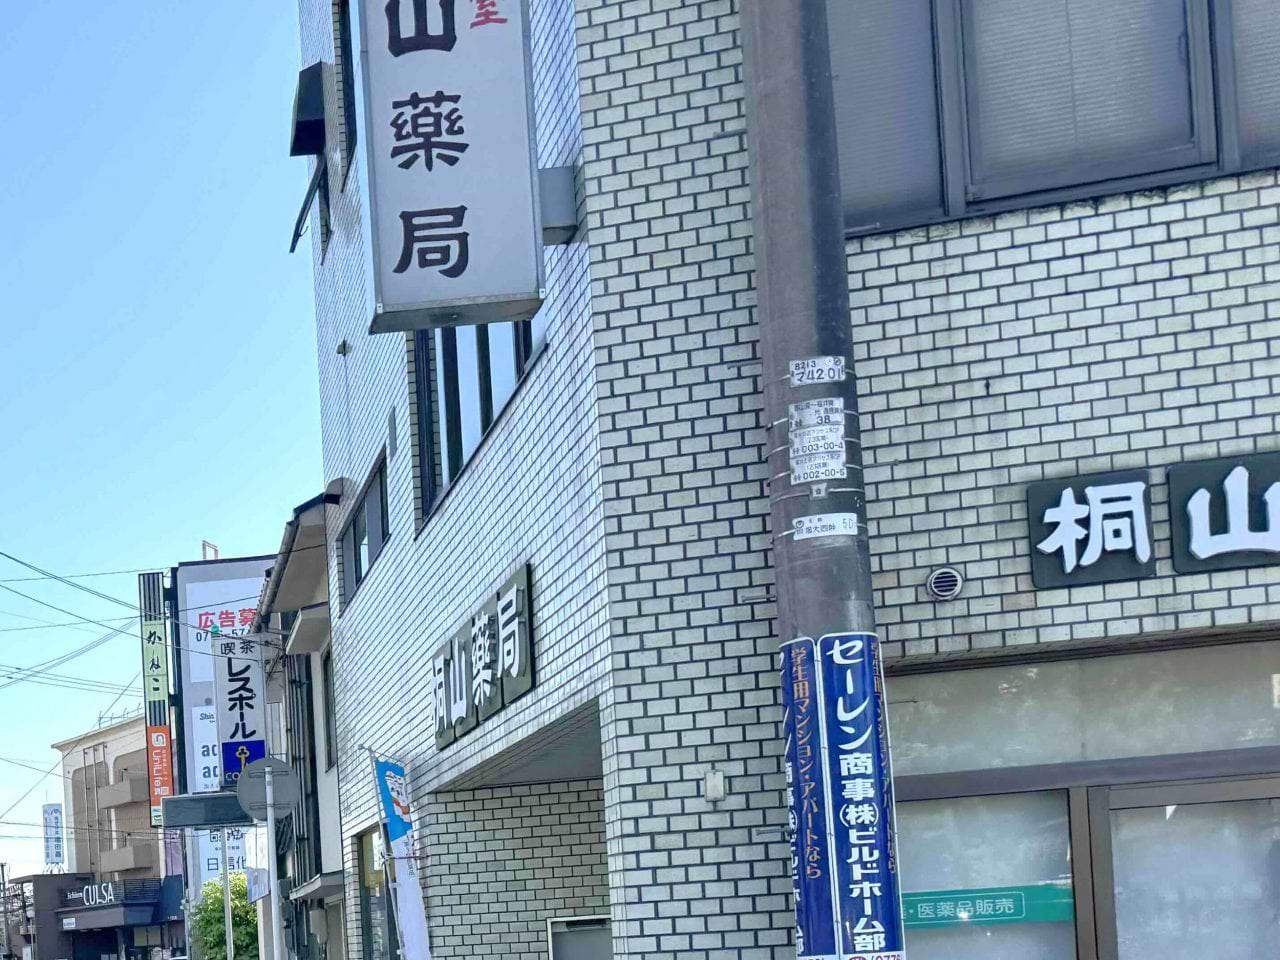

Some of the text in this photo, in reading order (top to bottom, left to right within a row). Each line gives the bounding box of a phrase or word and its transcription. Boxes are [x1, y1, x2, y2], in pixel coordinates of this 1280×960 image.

[220, 640, 256, 656] 喫茶
[227, 656, 257, 740] レスポール
